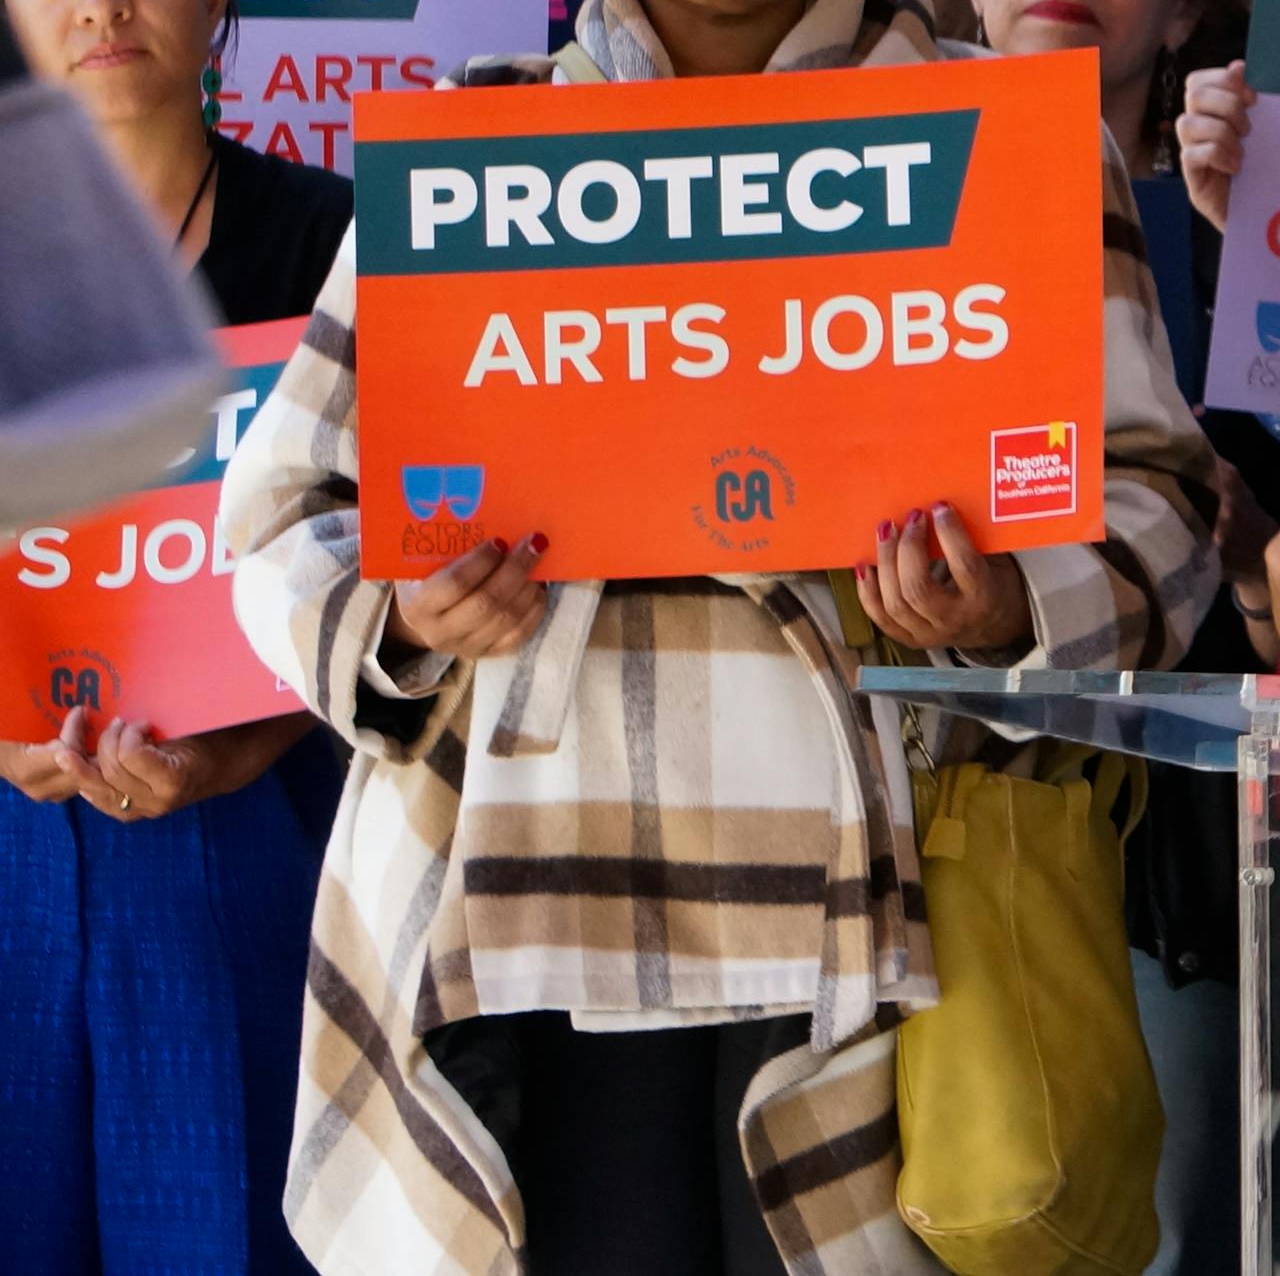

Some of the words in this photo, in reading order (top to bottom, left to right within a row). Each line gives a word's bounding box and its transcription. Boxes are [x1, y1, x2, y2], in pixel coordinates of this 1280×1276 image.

[409, 142, 931, 252] PROTECT
[463, 302, 731, 389] ARTS
[758, 283, 1010, 377] JOBS
[997, 464, 1071, 484] Producers
[1003, 453, 1061, 472] Theatre
[715, 468, 775, 524] CA
